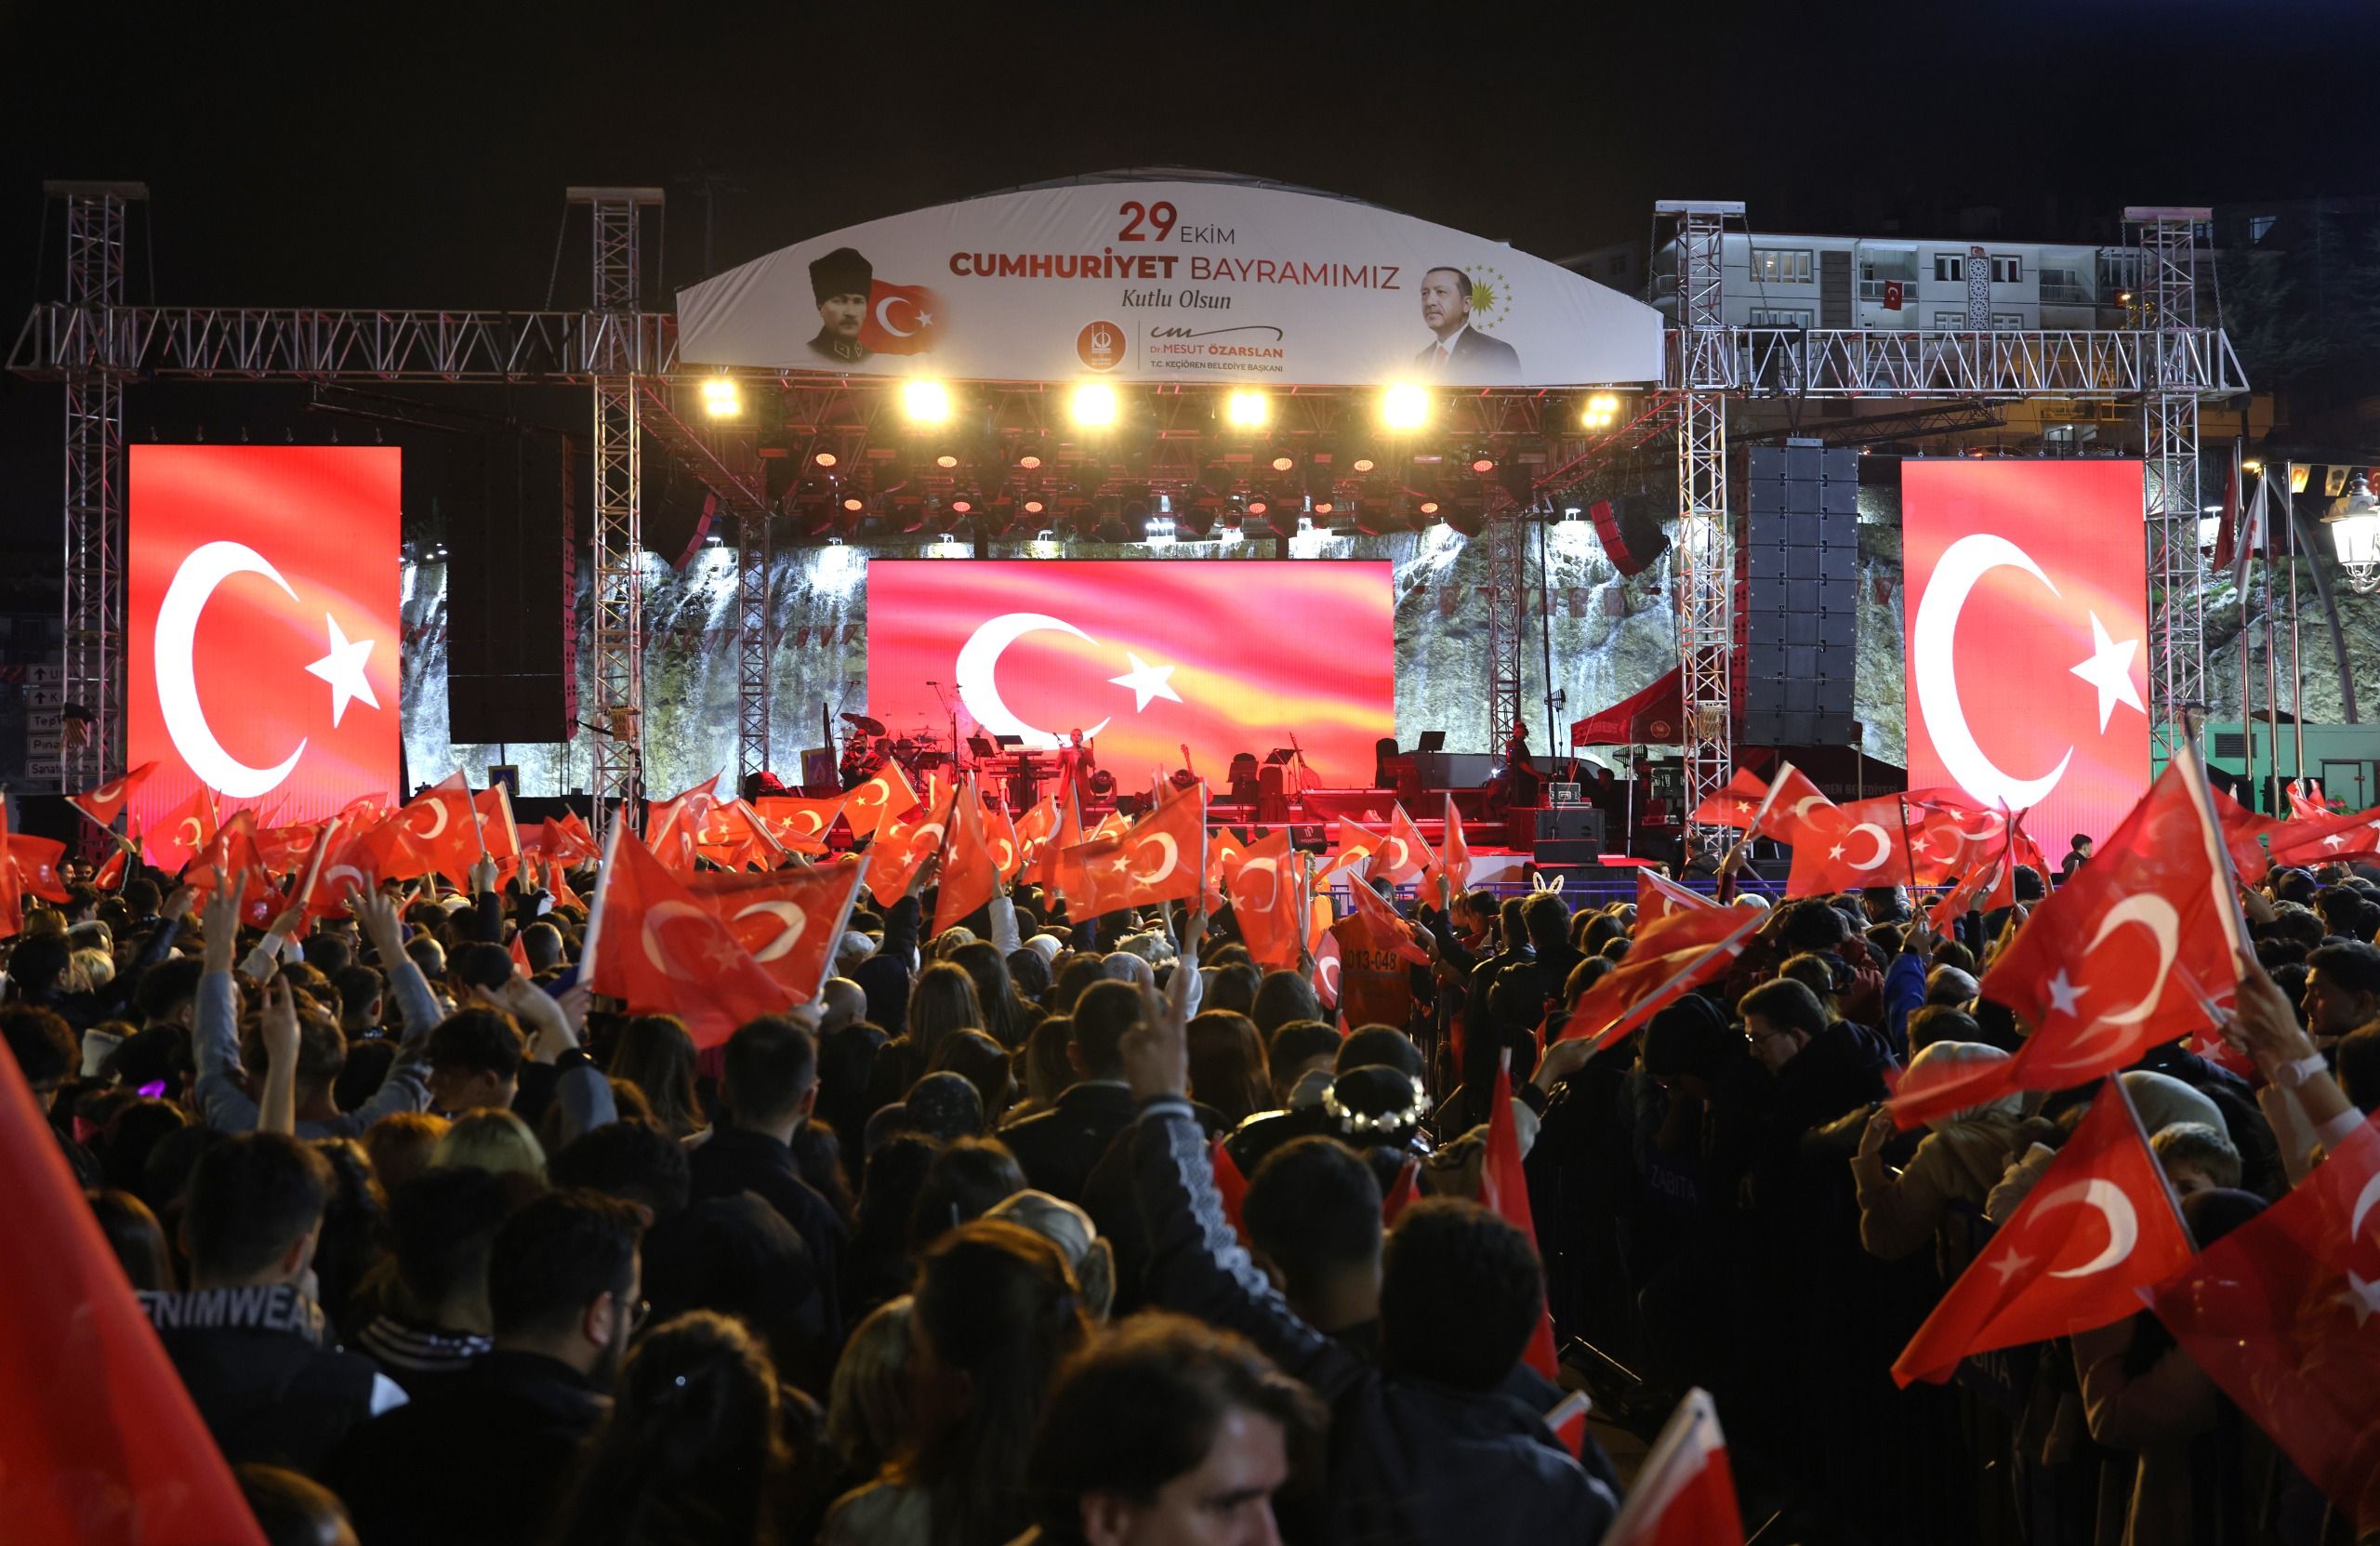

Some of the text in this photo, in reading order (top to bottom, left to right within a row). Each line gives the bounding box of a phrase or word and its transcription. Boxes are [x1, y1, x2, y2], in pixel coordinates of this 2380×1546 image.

[1118, 201, 1235, 245] 29 EKİM
[949, 246, 1400, 290] CUMHURİYET BAYRAMIMIZ
[1121, 288, 1232, 310] Kutlu Olsun
[1163, 344, 1205, 354] MESUT
[1208, 343, 1284, 358] ÖZARSLAN
[1165, 359, 1206, 370] KEÇİÖREN
[1207, 361, 1246, 371] BELEDİYE
[1248, 363, 1283, 373] BAŞKANI
